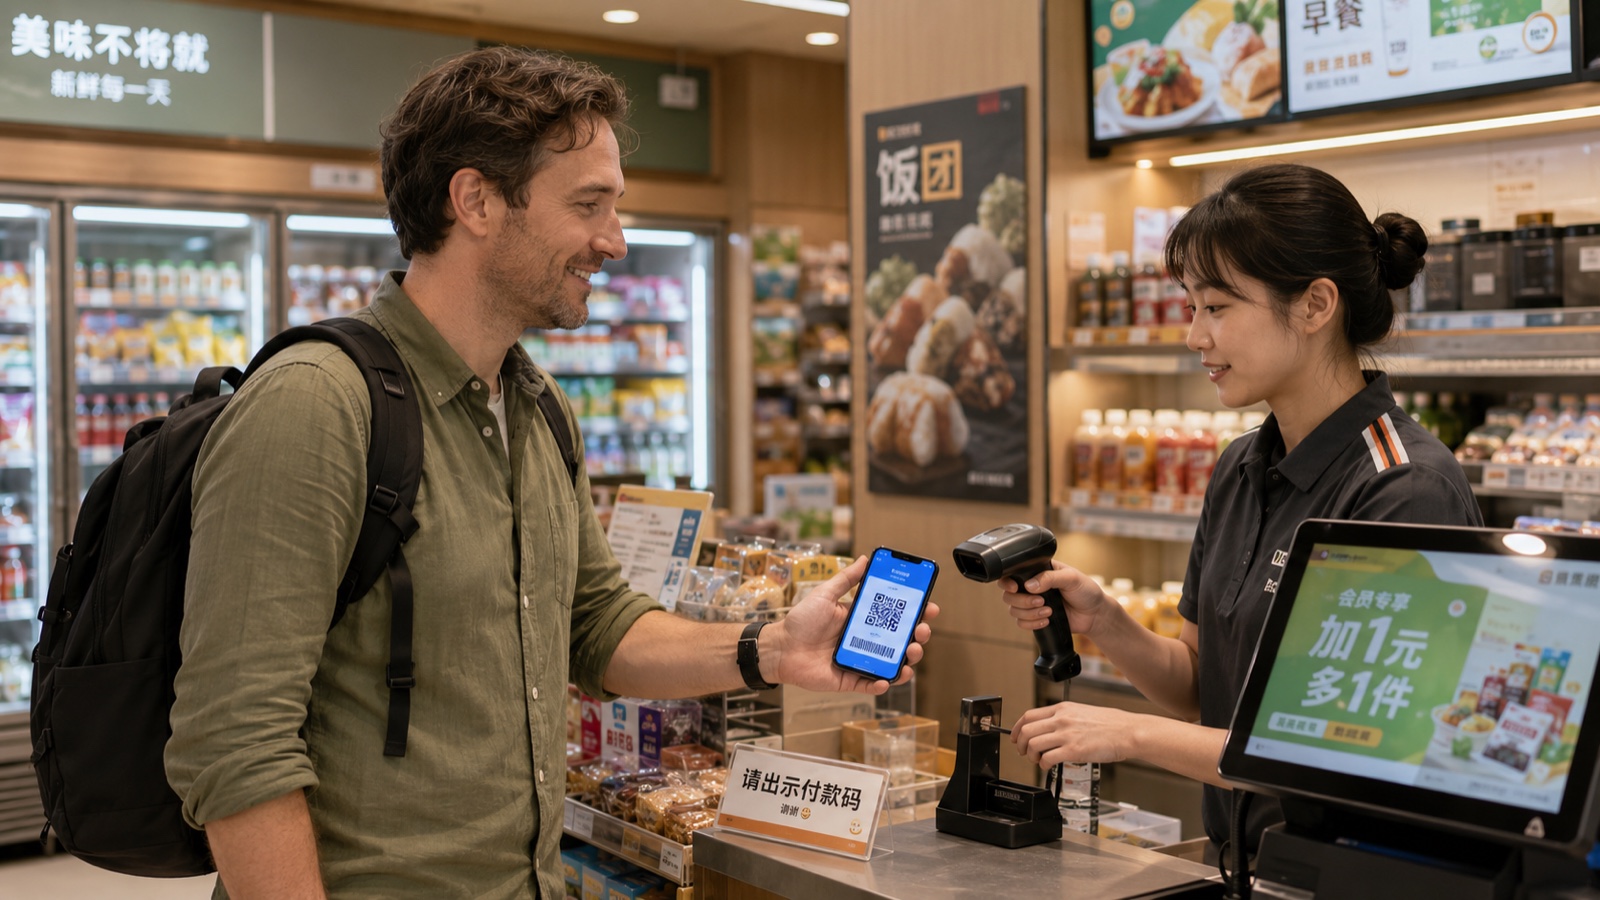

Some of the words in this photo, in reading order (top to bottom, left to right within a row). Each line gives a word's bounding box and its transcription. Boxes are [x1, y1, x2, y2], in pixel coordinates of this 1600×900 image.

[1303, 0, 1363, 35] 早餐
[11, 13, 209, 74] 美味不将就
[51, 69, 171, 107] 新鲜每一天
[877, 140, 963, 207] 饭团
[1338, 588, 1413, 612] 会员专享
[1308, 615, 1430, 671] 加1元
[1301, 665, 1415, 720] 多1件
[741, 767, 862, 812] 请出示付款码
